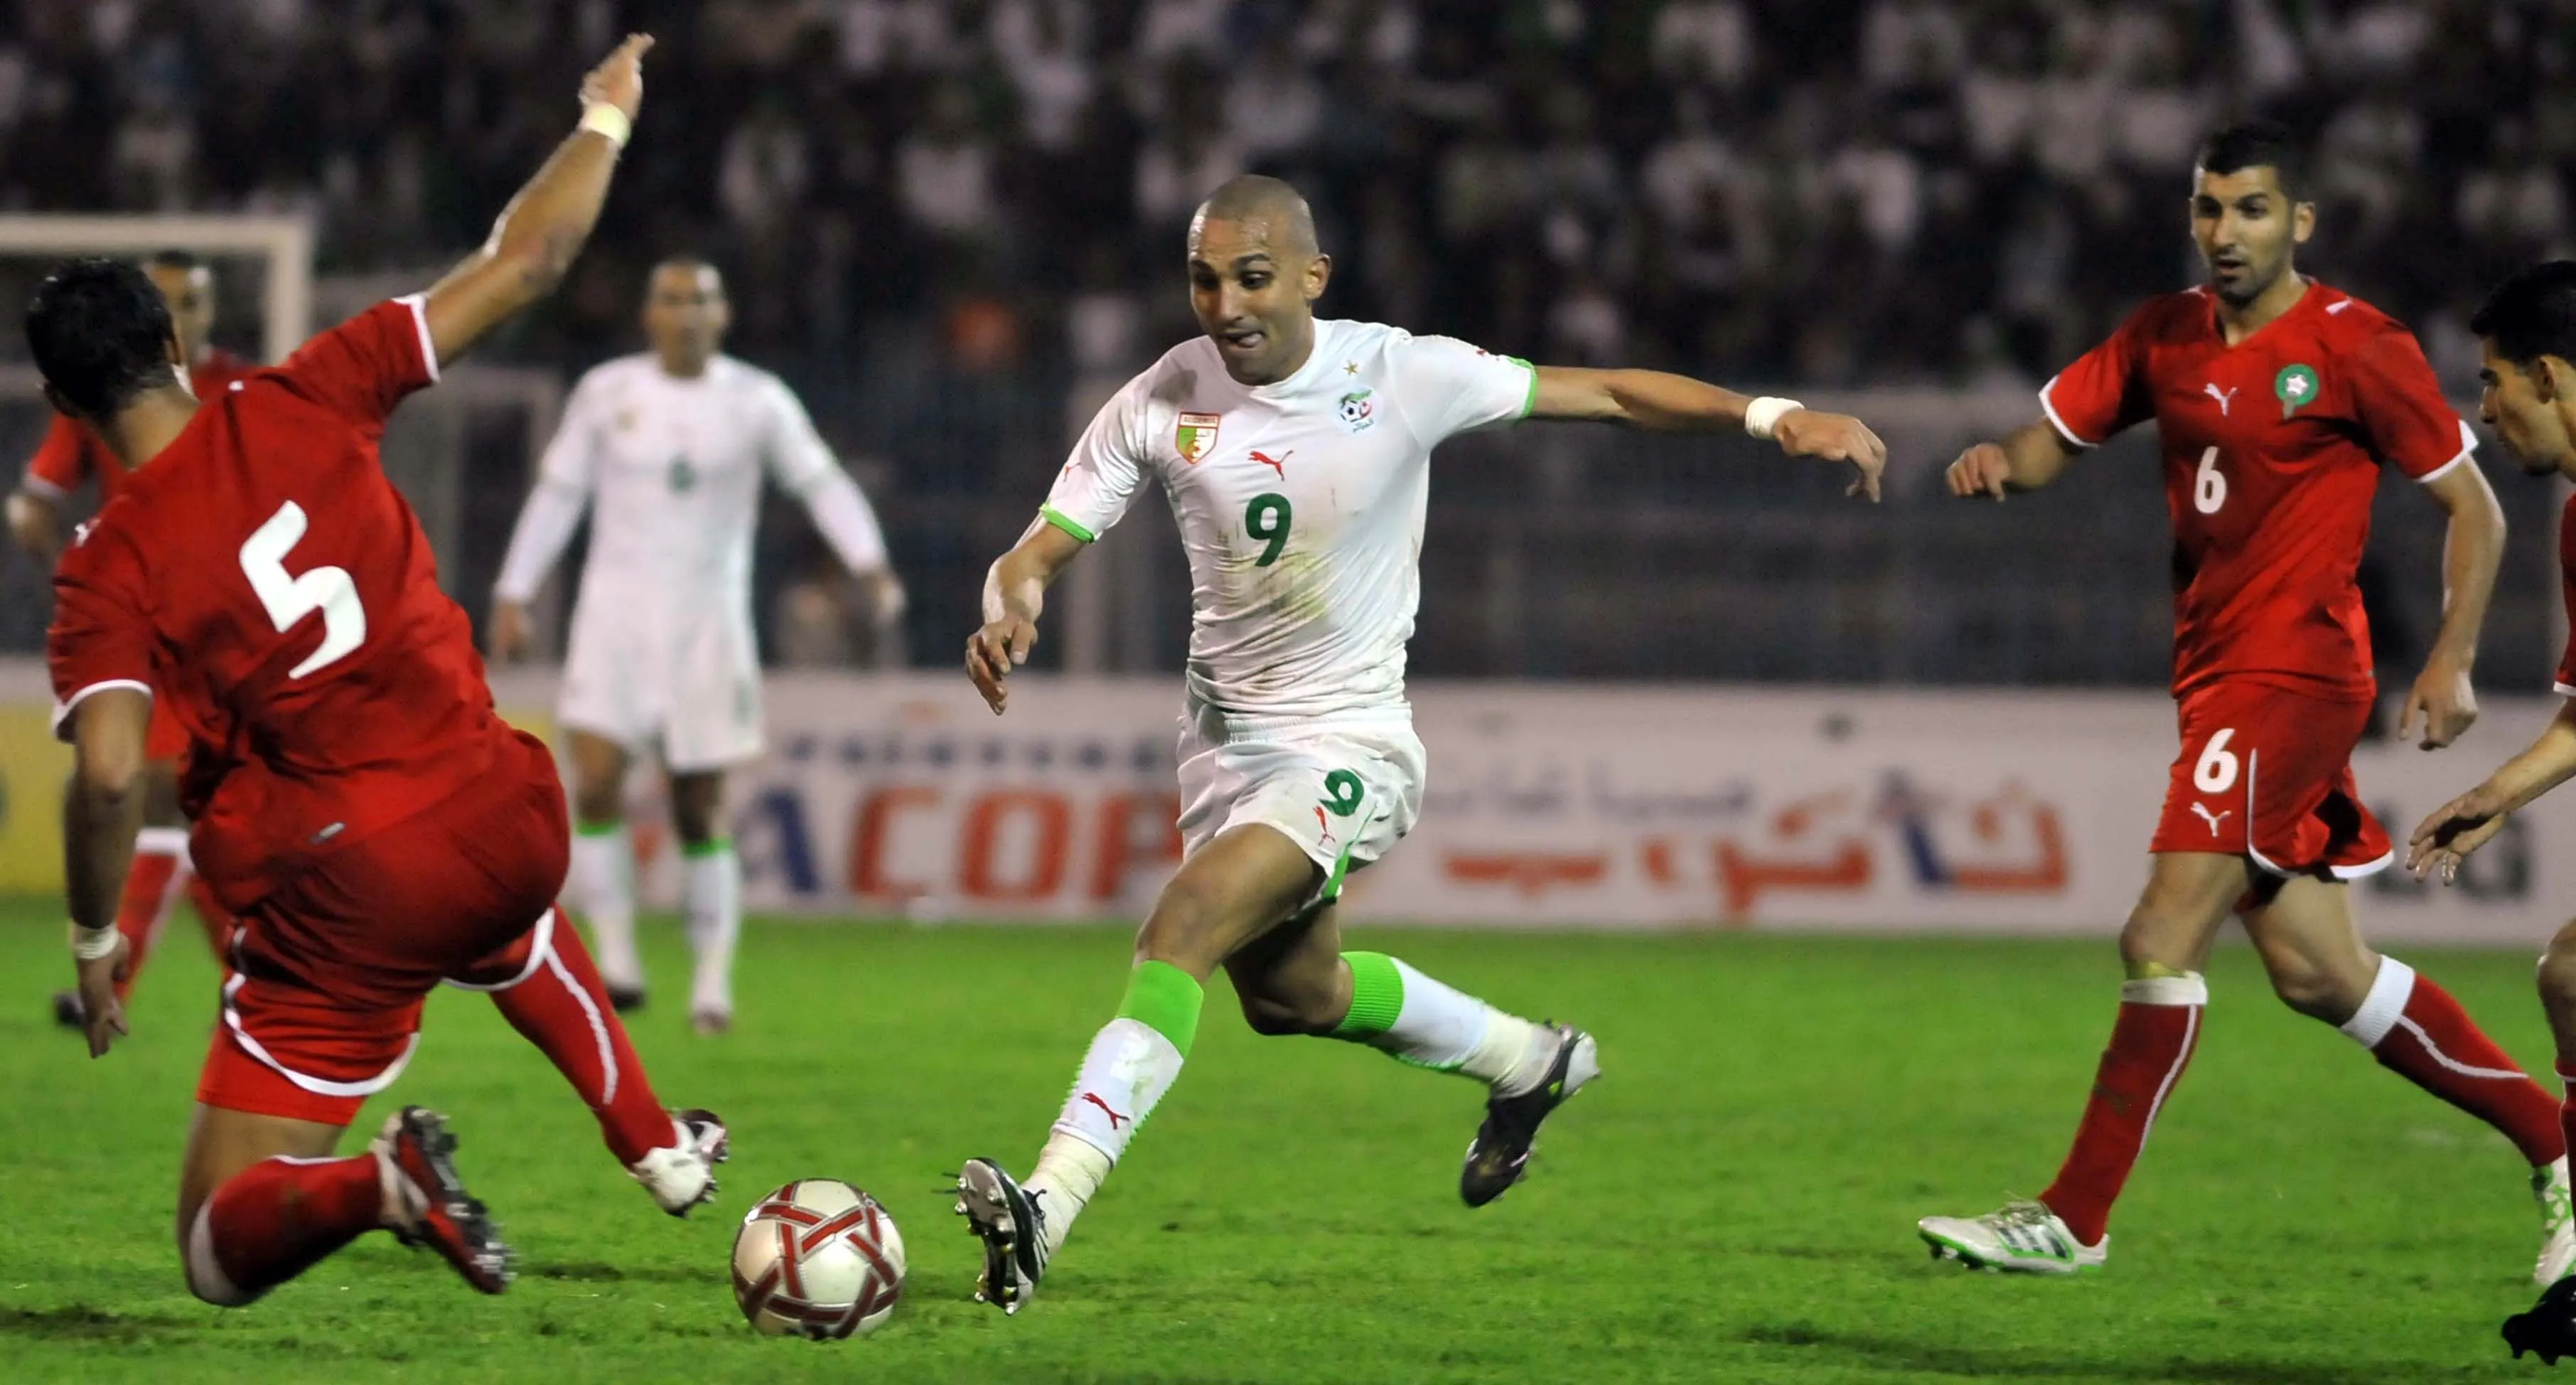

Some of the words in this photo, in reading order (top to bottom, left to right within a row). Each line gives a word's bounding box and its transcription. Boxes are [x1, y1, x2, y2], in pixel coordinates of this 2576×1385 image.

[2193, 445, 2228, 515] 6
[1245, 492, 1292, 567] 9
[239, 499, 367, 680] 5
[1318, 769, 1364, 817] 9
[2193, 727, 2239, 794] 6
[632, 782, 1186, 903] ACOP
